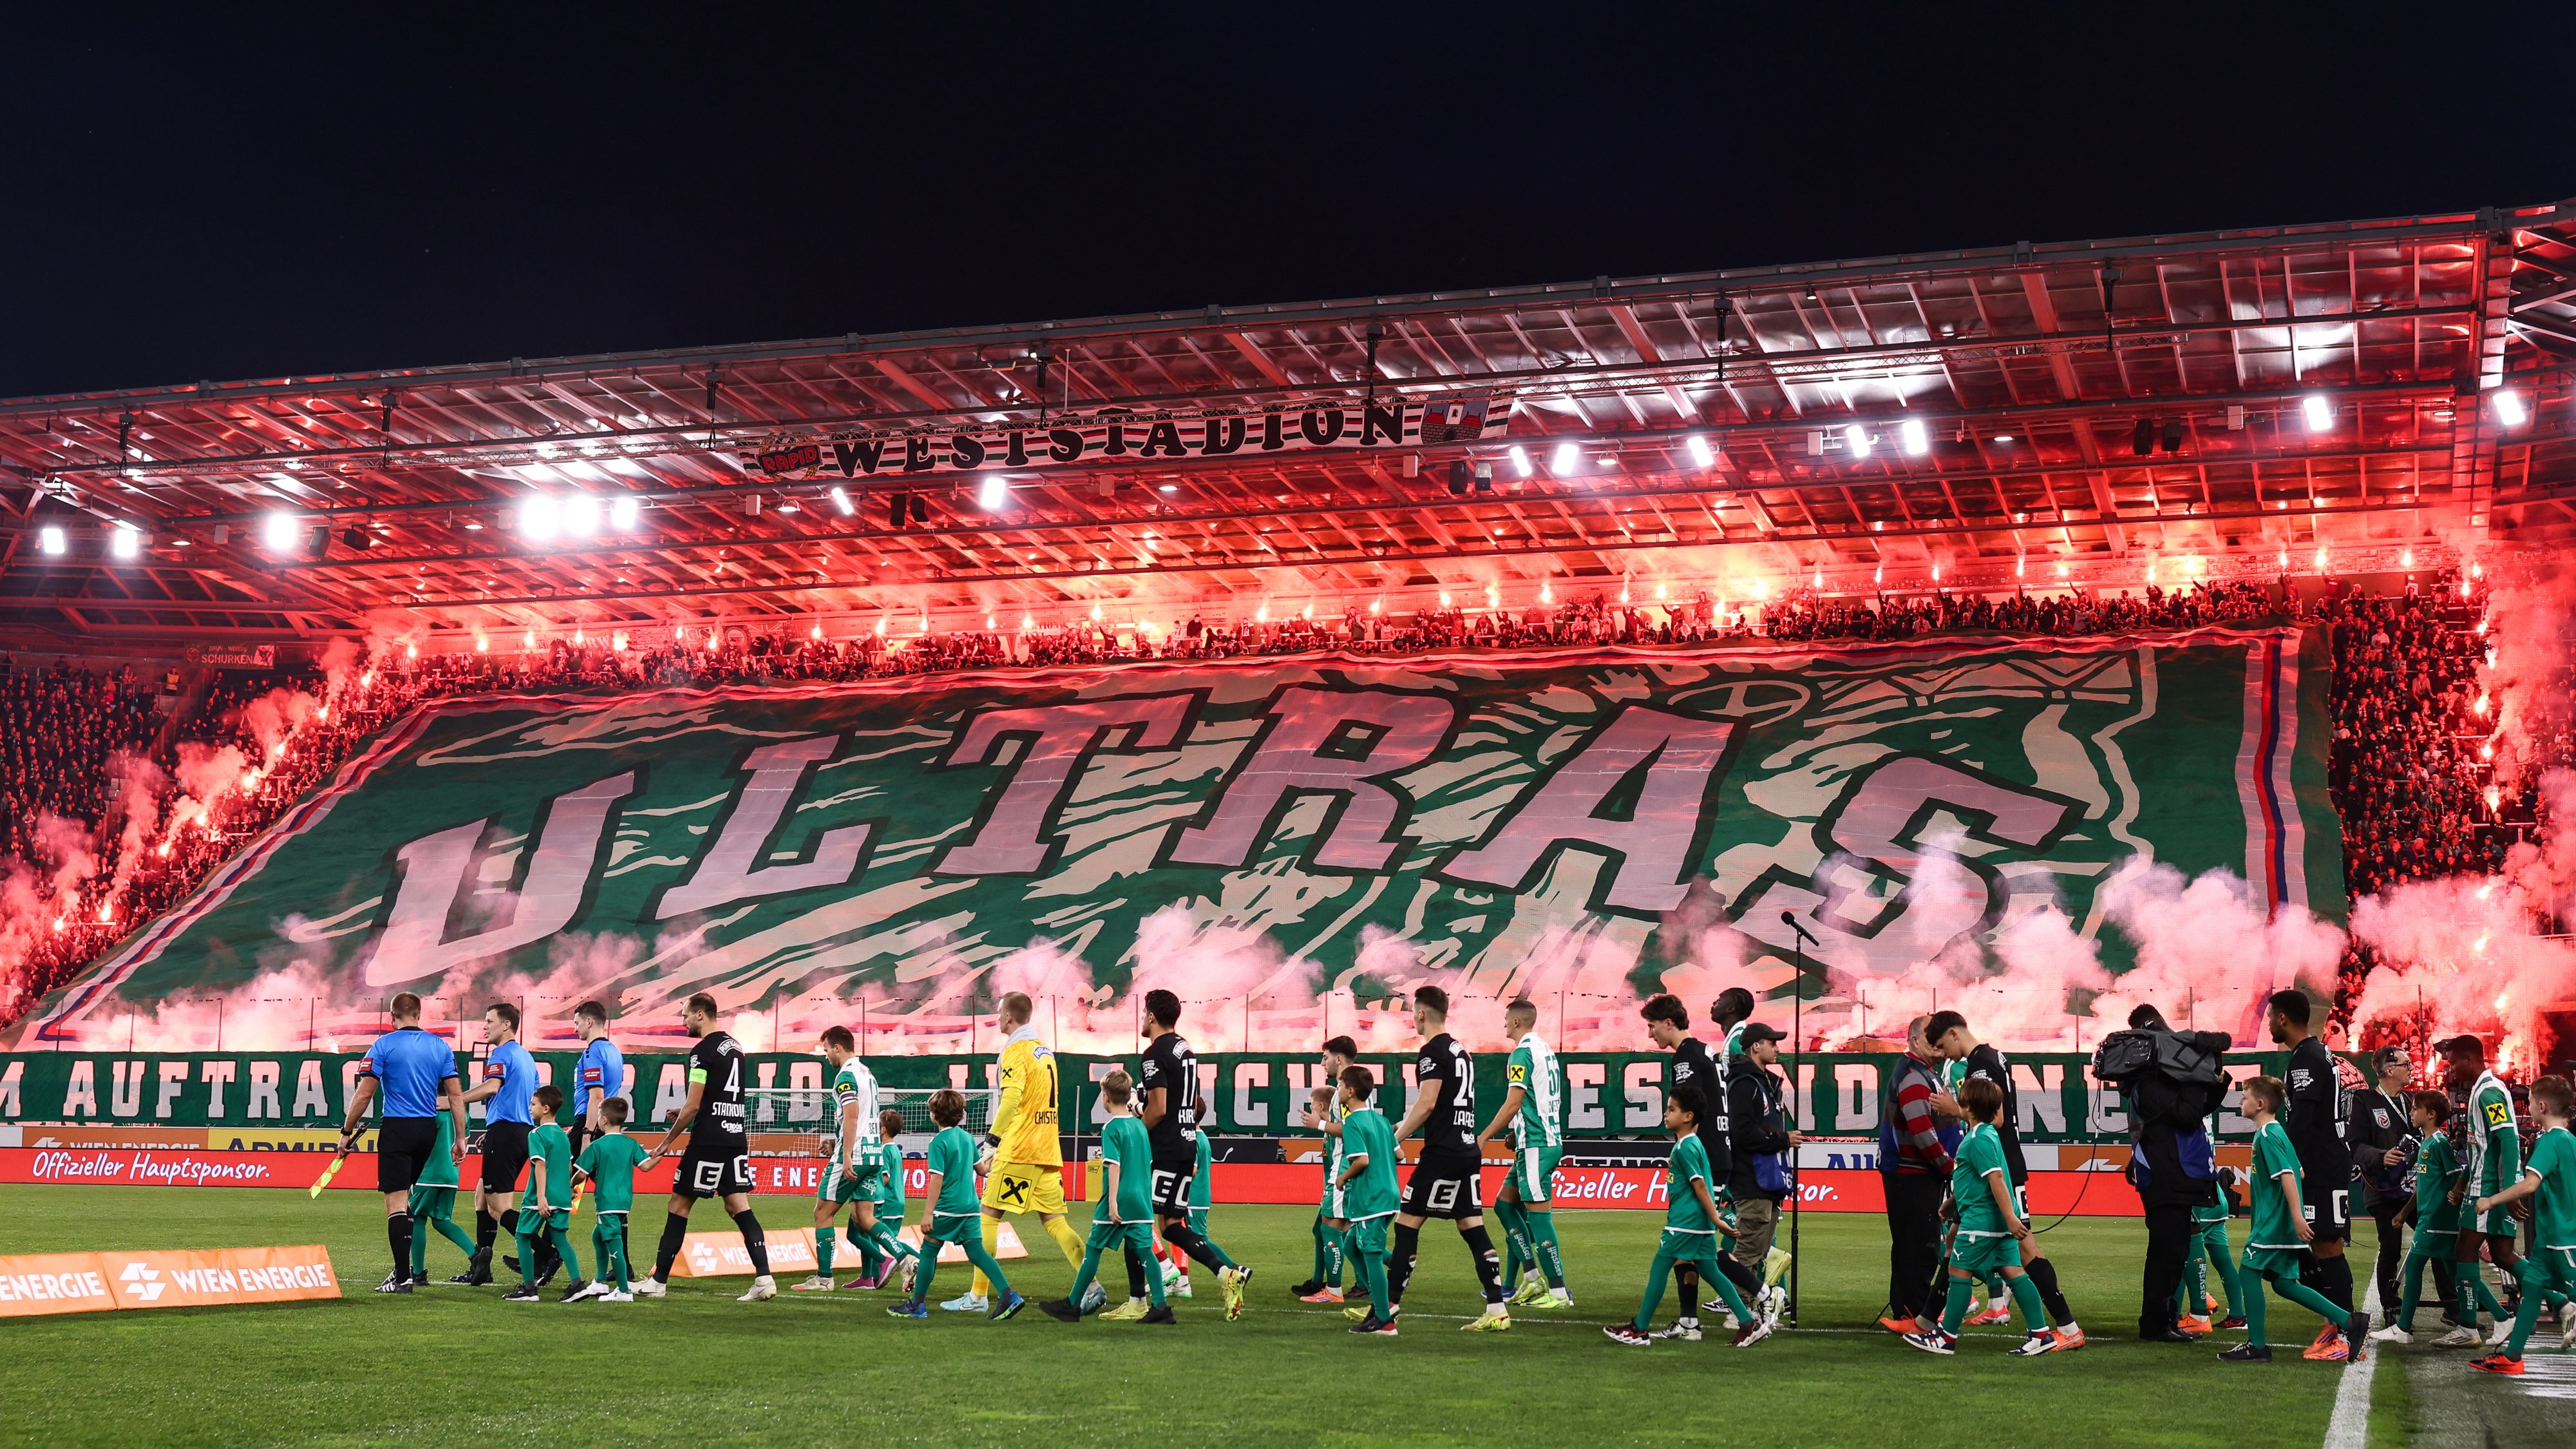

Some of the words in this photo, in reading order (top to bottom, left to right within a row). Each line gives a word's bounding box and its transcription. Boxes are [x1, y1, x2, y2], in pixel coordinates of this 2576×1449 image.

[831, 395, 1408, 477] WESTSTADION
[762, 448, 819, 472] RAPID
[202, 654, 253, 665] SCHURKEN
[364, 683, 2077, 989] ULTRAS
[724, 1057, 741, 1102] 4
[1046, 1064, 1056, 1108] 1
[1182, 1058, 1197, 1107] 17
[1454, 1057, 1475, 1108] 24
[32, 1151, 125, 1179] Offizieller
[129, 1151, 270, 1185] Hauptsponsor.
[880, 1231, 902, 1254] easystaff
[1547, 1245, 1562, 1276] easystaff
[0, 1271, 106, 1301] ENERGIE
[170, 1267, 240, 1294] WIEN
[242, 1264, 332, 1293] ENERGIE
[2198, 1263, 2207, 1300] easystaff
